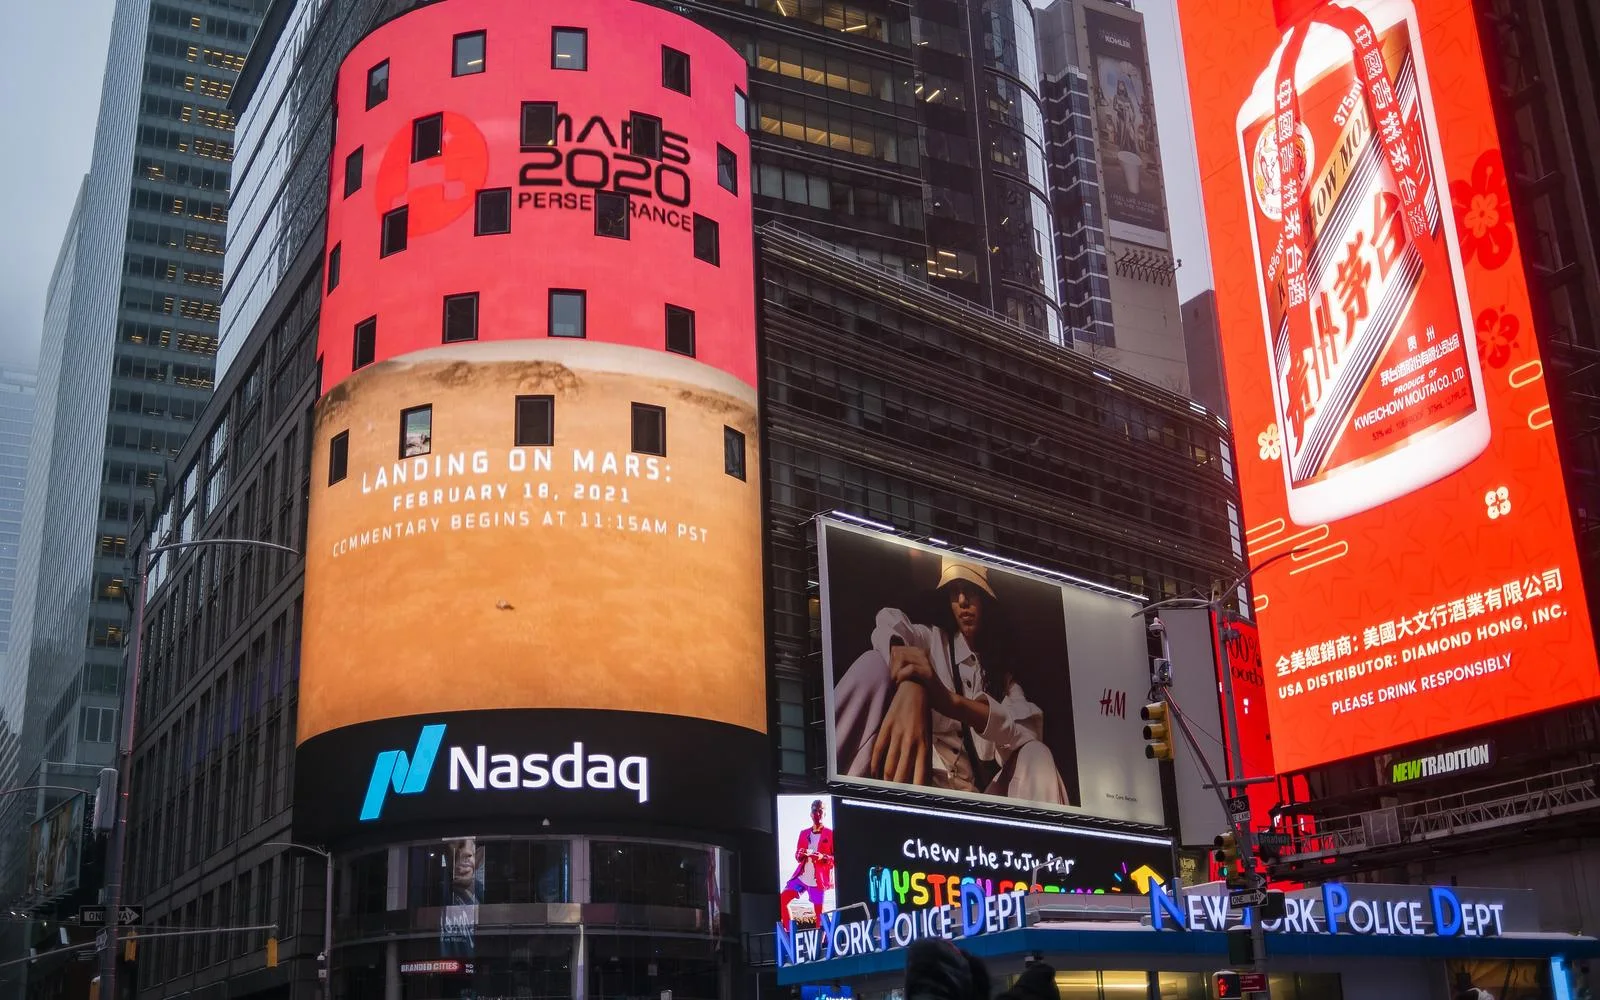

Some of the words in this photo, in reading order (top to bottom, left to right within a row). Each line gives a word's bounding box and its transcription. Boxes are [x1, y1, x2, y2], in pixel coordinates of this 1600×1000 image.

[519, 146, 691, 207] 2020
[518, 191, 692, 232] PERSERANCE
[1393, 374, 1425, 396] PRODUCE
[1428, 367, 1438, 379] OF
[1354, 397, 1405, 431] KWEICHOW
[1405, 379, 1438, 408] MOUTAI
[362, 451, 488, 494] LANDING
[508, 448, 552, 472] ON
[573, 448, 672, 483] MARS:
[393, 483, 507, 512] FEBRUARY
[523, 482, 559, 501] 18,
[573, 483, 629, 504] 2021
[332, 517, 440, 557] COMMENTARY
[450, 511, 529, 530] BEGINS
[542, 511, 566, 526] AT
[580, 511, 668, 535] 11:15AM
[677, 523, 708, 543] PST
[1278, 682, 1303, 700] USA
[1307, 653, 1398, 690] DISTRIBUTOR:
[1402, 631, 1472, 664] DIAMOND
[1477, 614, 1529, 641] HONG,
[1532, 604, 1568, 627] INC.
[1099, 688, 1126, 720] H&M
[1331, 690, 1375, 716] PLEASE
[1378, 679, 1418, 704] DRINK
[1421, 652, 1513, 691] RESPONSIBLY
[449, 740, 650, 803] Nasdaq
[903, 838, 960, 864] Chew
[966, 845, 999, 870] the
[1002, 850, 1040, 872] JuJu
[1150, 876, 1229, 931] NEW
[1321, 882, 1425, 934] POLICE
[1430, 887, 1504, 936] DEPT
[1232, 895, 1244, 904] ONE
[1249, 892, 1262, 904] WAY
[776, 920, 819, 967] NEW
[820, 911, 874, 961] YORK
[878, 900, 953, 951] POLICE
[960, 883, 1025, 938] DEPT
[433, 961, 458, 970] CITIES
